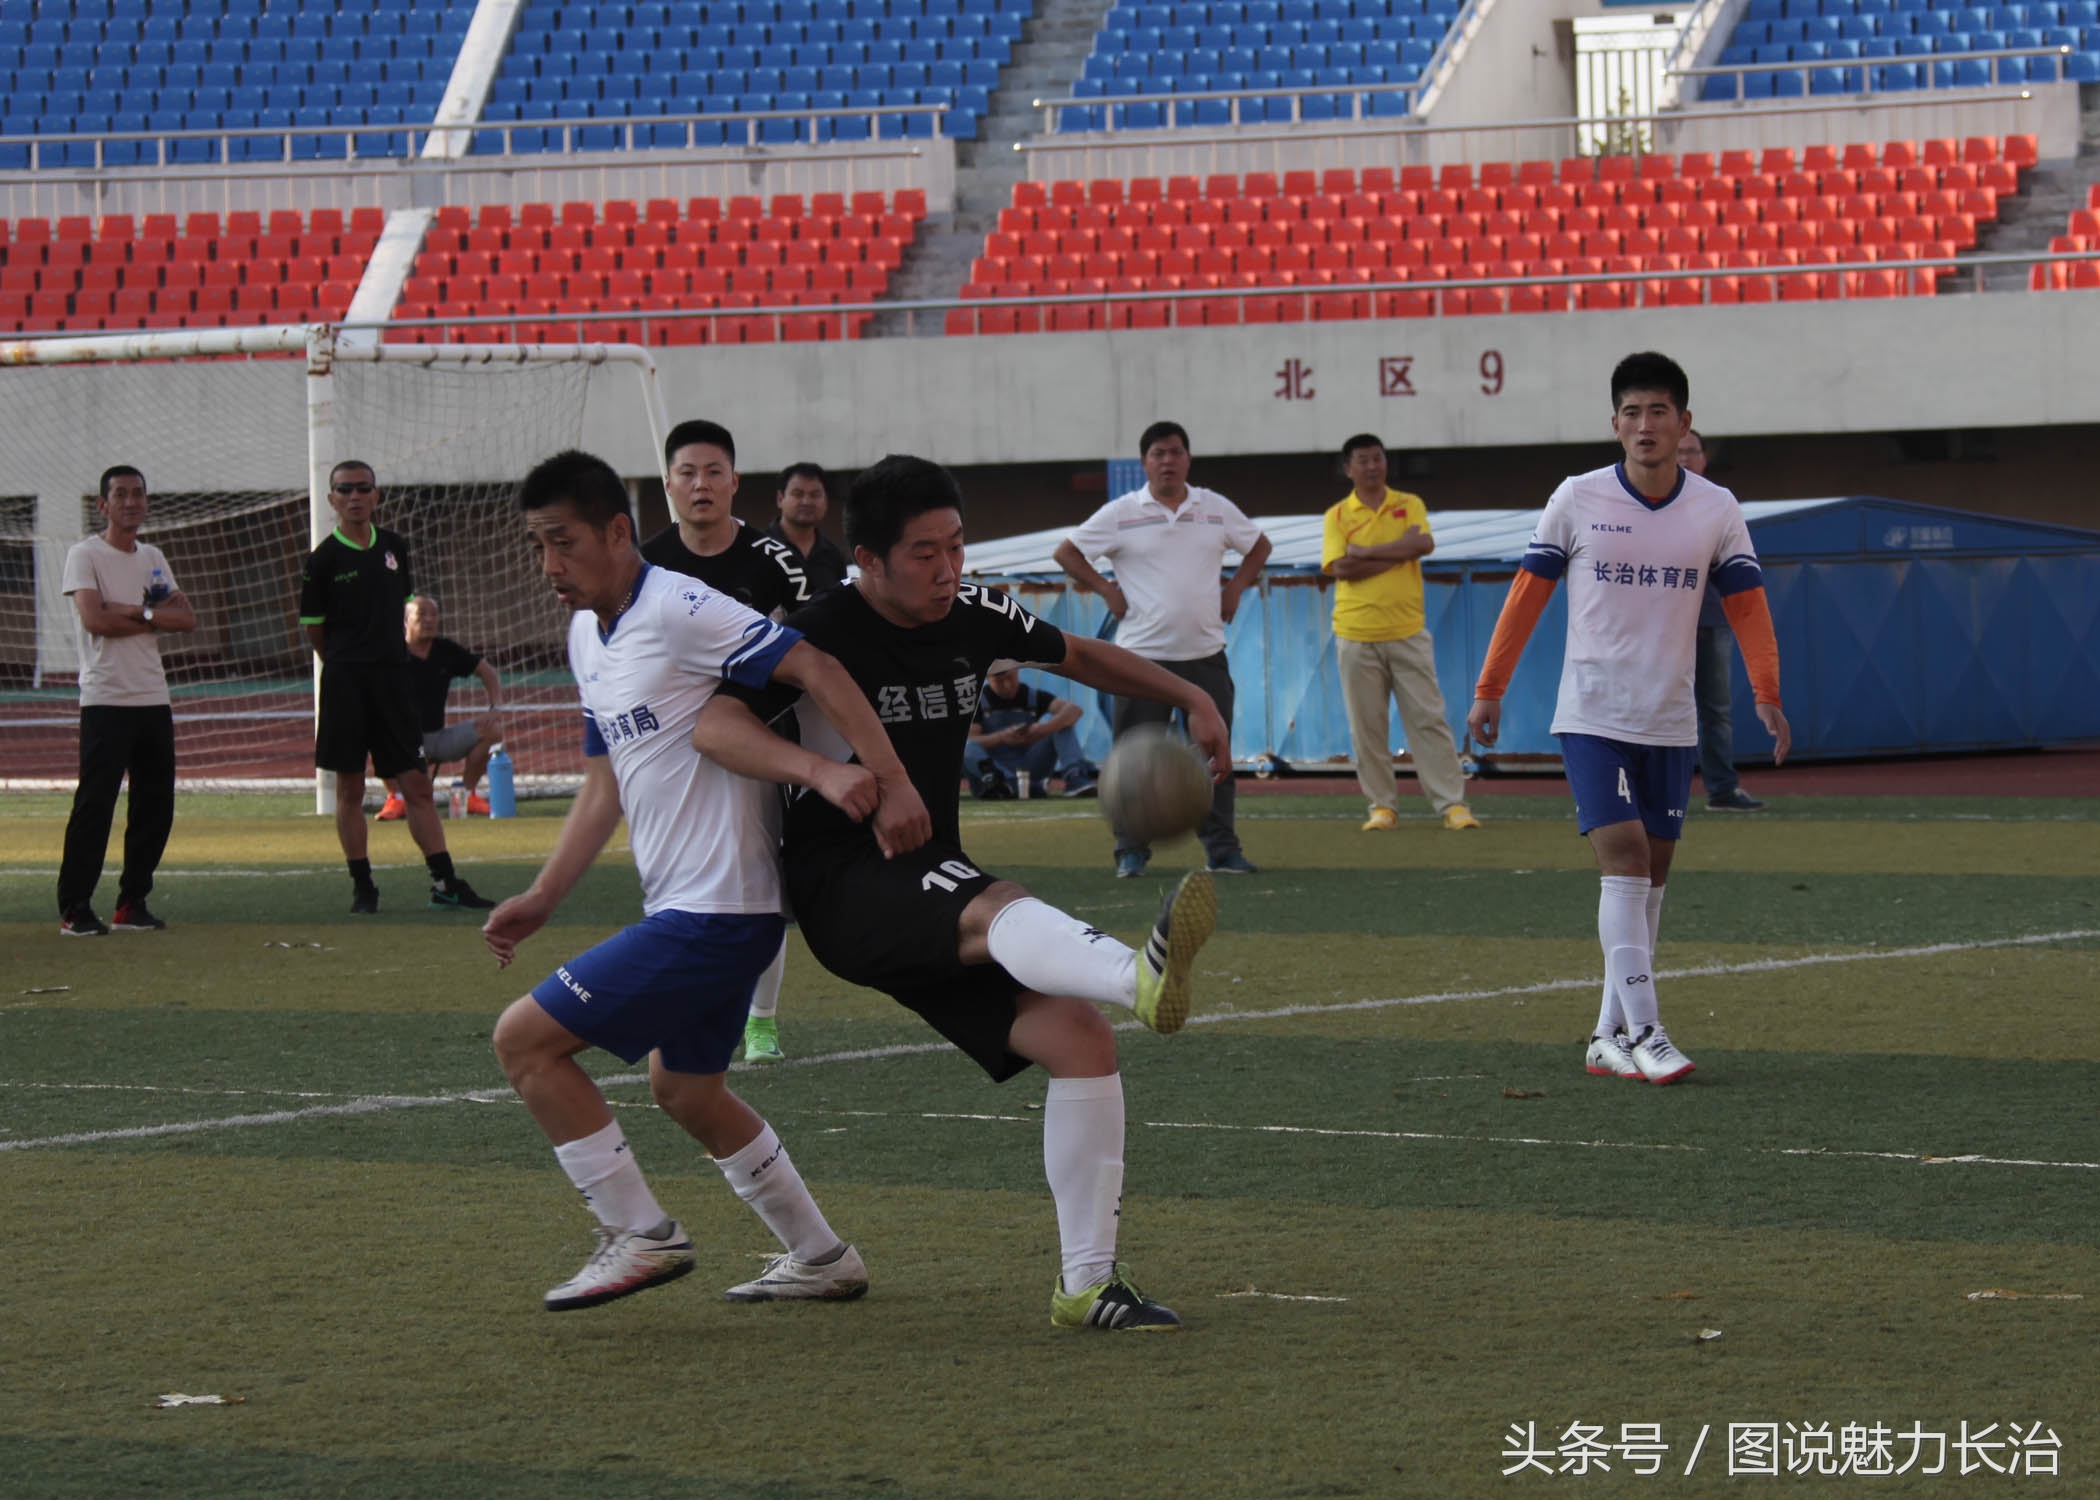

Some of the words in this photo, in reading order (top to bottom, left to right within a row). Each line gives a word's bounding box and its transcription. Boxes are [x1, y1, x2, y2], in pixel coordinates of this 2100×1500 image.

[1591, 523, 1633, 534] KELME
[1593, 560, 1699, 590] 长治体育局
[957, 583, 1037, 634] RUN
[878, 673, 978, 723] 经信委
[1617, 766, 1632, 804] 4
[921, 860, 982, 893] 10
